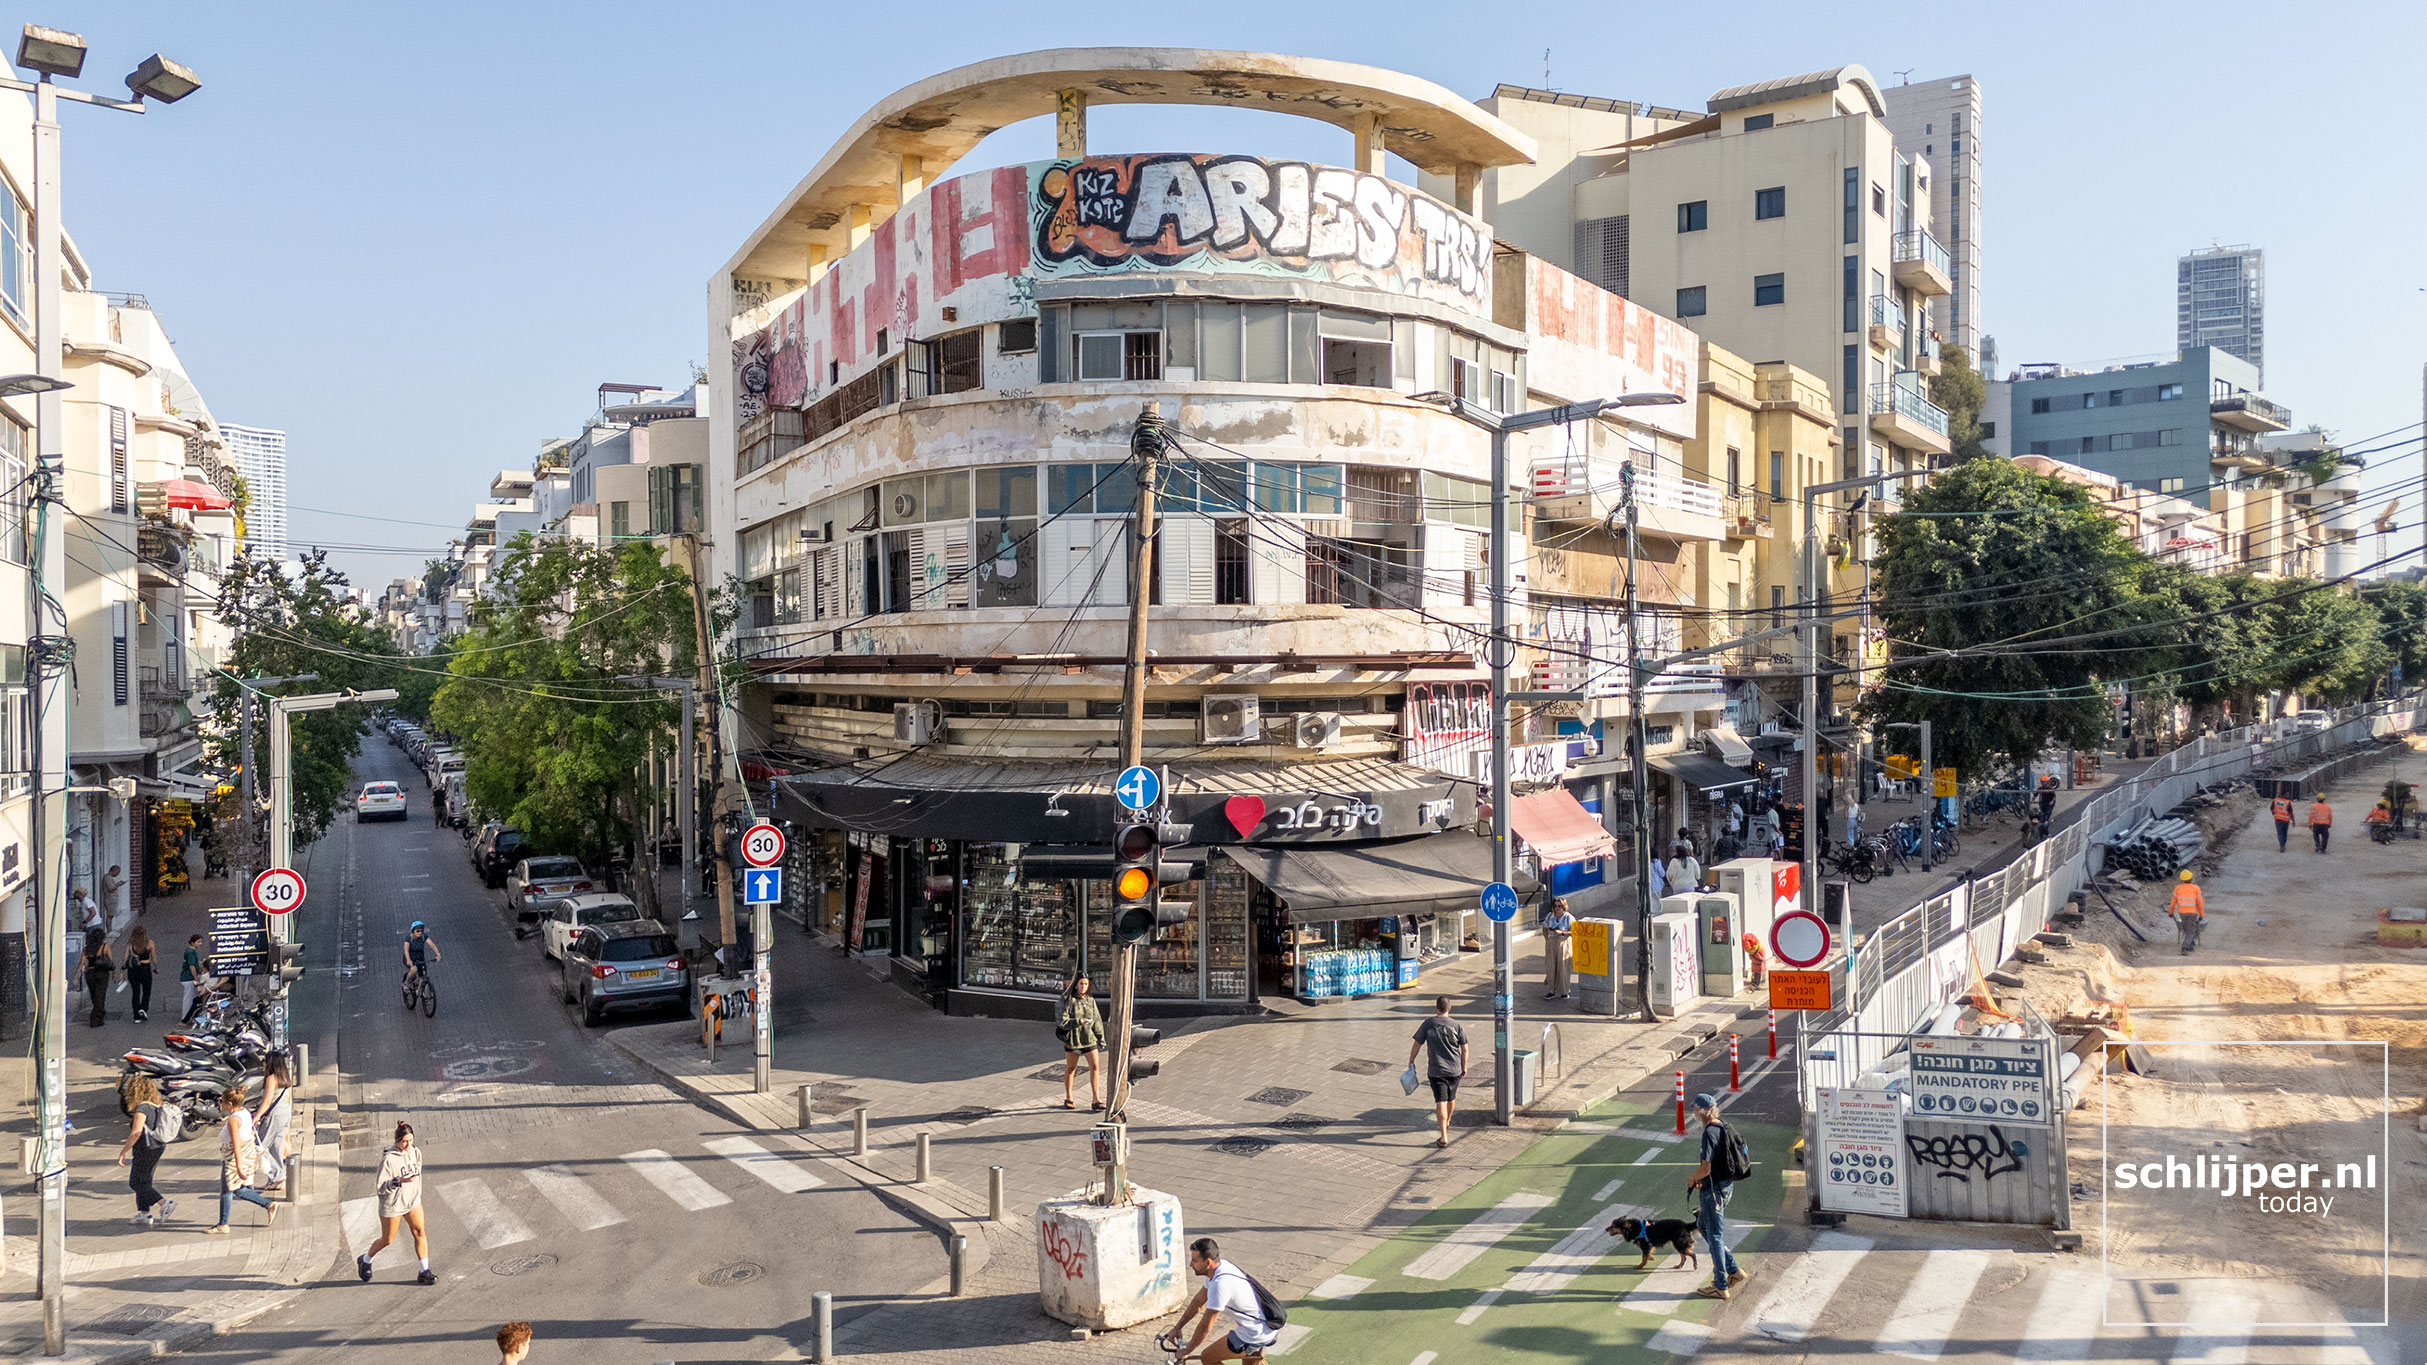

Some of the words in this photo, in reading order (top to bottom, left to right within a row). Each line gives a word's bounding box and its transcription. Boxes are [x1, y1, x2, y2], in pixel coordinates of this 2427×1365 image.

[1121, 155, 1408, 269] ARIES
[752, 838, 774, 853] 30
[266, 884, 292, 900] 30
[1771, 975, 1797, 984] האתר
[1799, 974, 1827, 985] לעובדי
[1784, 986, 1815, 995] הכניסה
[1786, 997, 1815, 1006] מותרת
[1917, 1054, 1964, 1069] חובה!
[1969, 1058, 1997, 1072] מגן
[2003, 1060, 2037, 1073] ציוד
[1917, 1075, 2008, 1090] MANDATORY
[2012, 1080, 2040, 1092] PPE
